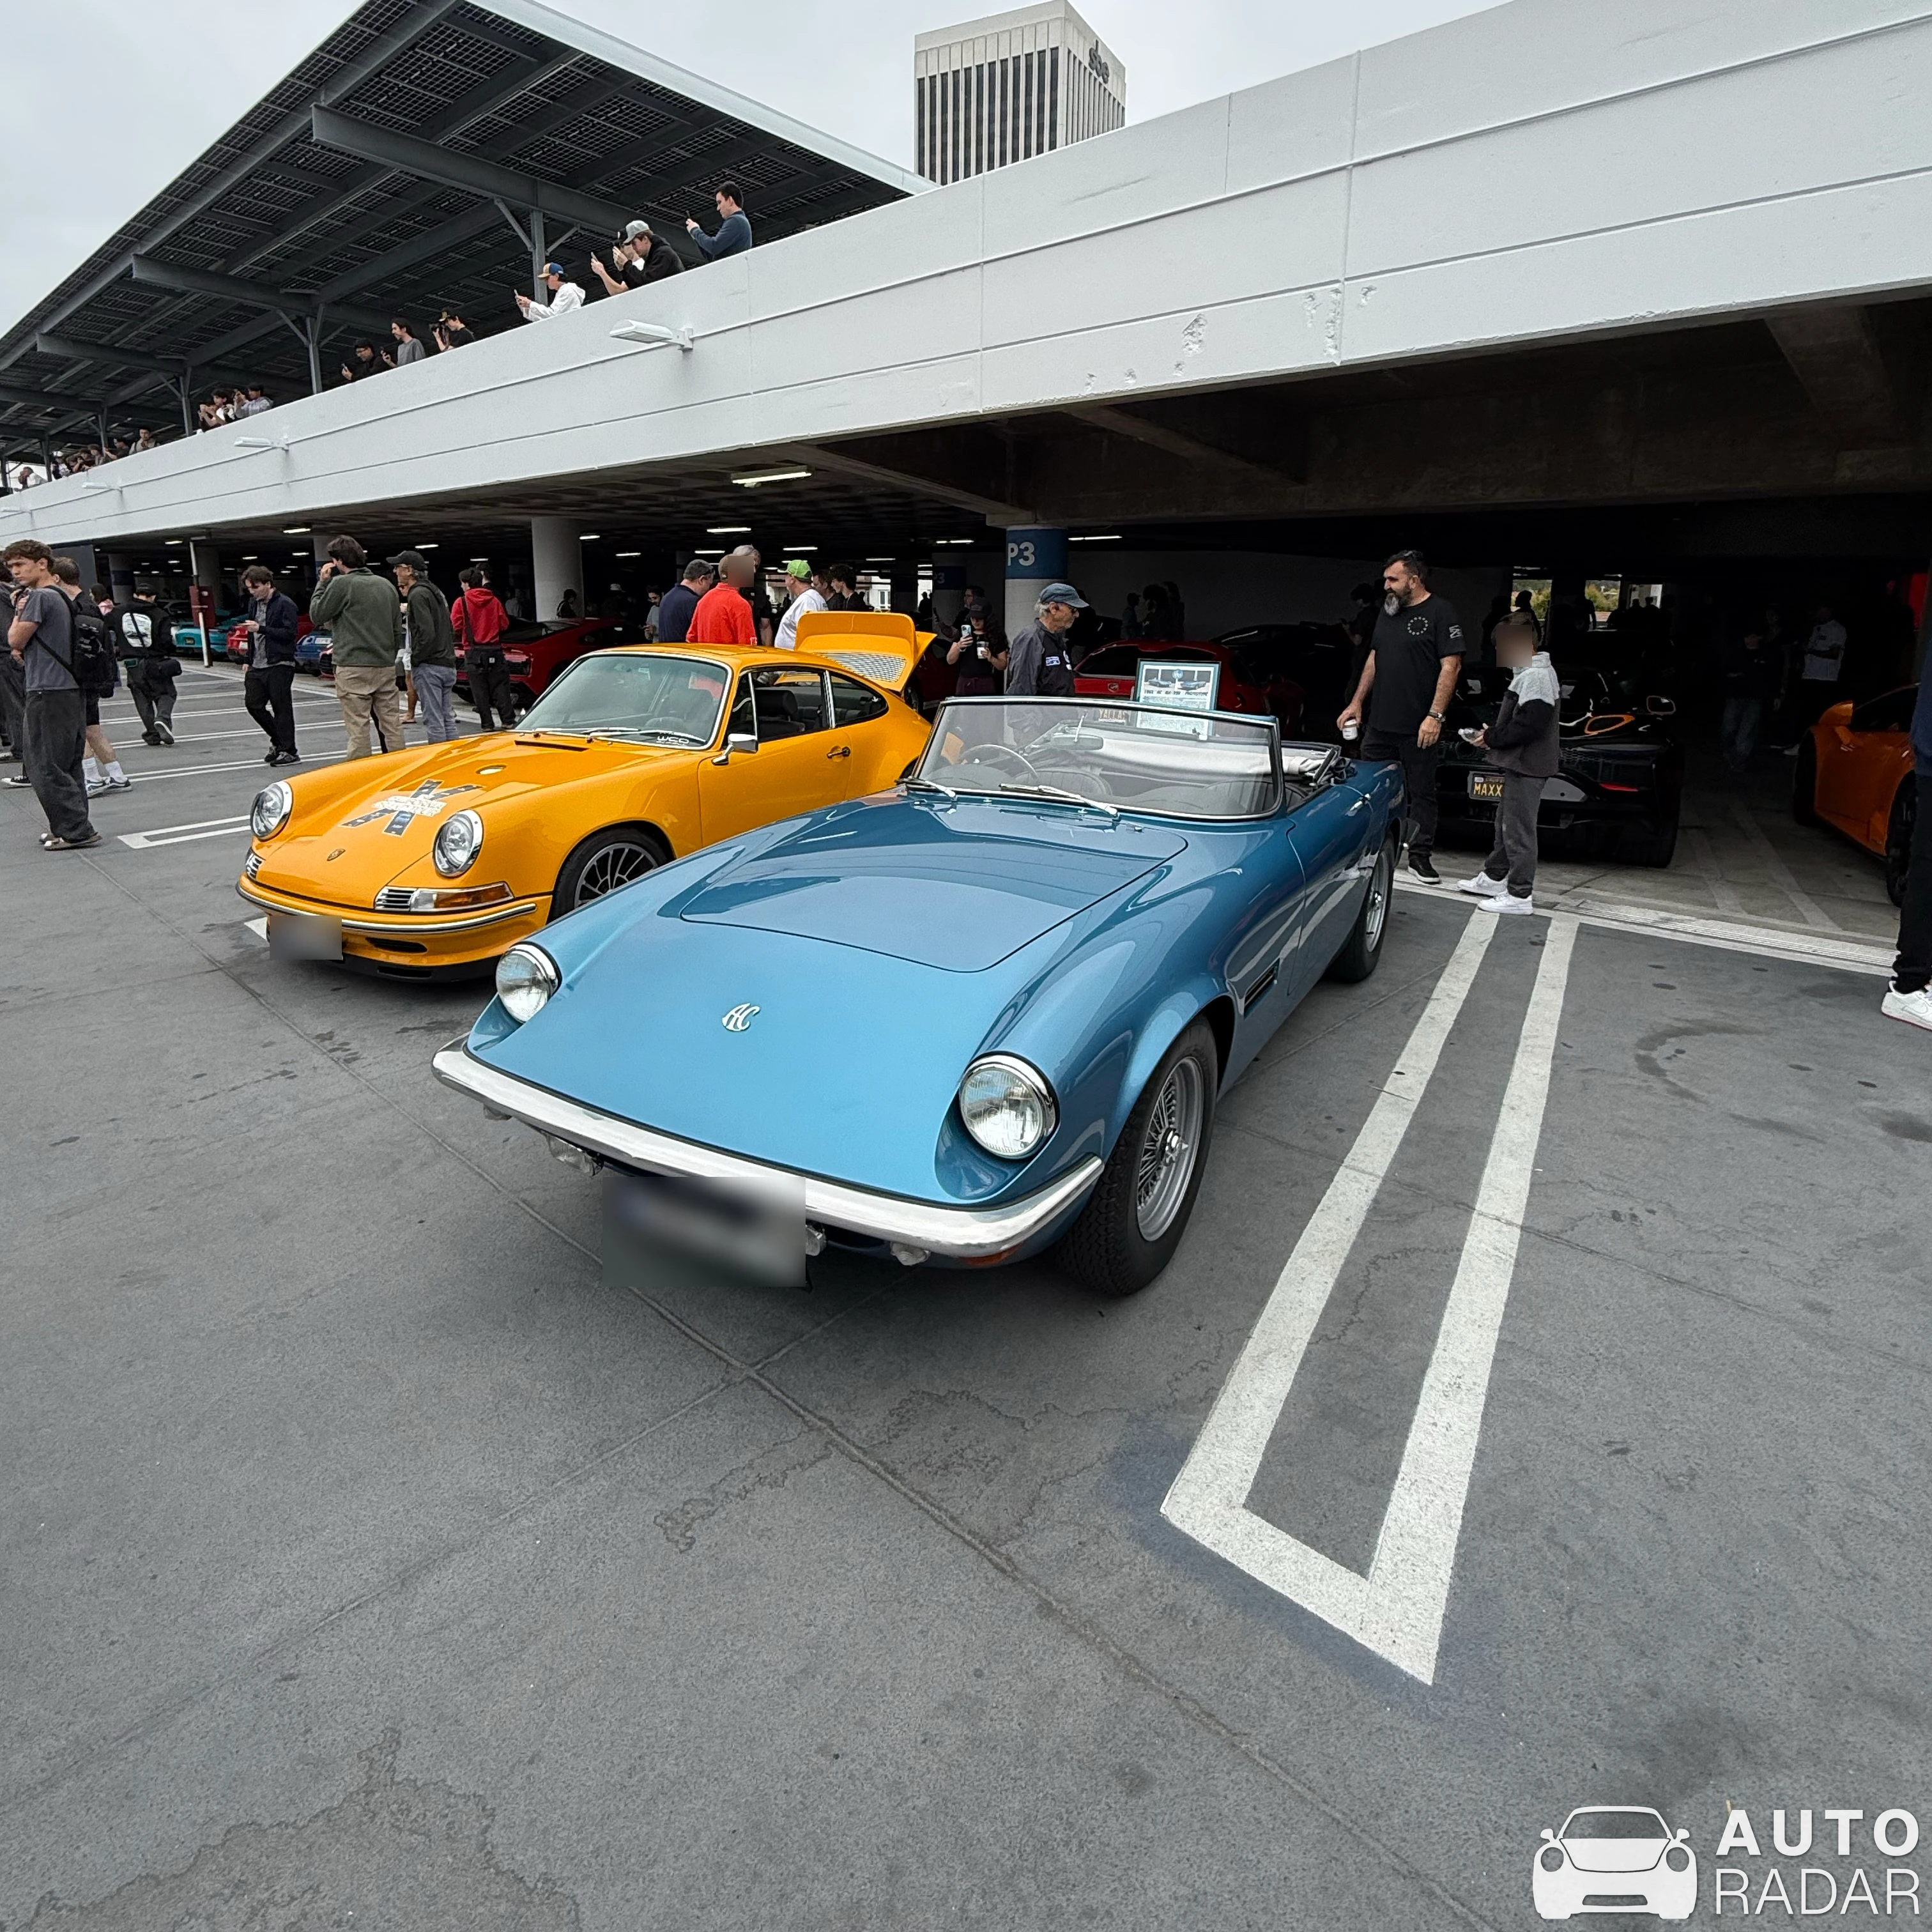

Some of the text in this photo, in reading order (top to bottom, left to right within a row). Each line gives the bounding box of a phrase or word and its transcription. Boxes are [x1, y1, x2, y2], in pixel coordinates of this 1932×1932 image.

[1089, 39, 1110, 84] sbe
[1007, 541, 1035, 566] P3
[1473, 782, 1503, 797] MAXX
[722, 1002, 760, 1031] AC
